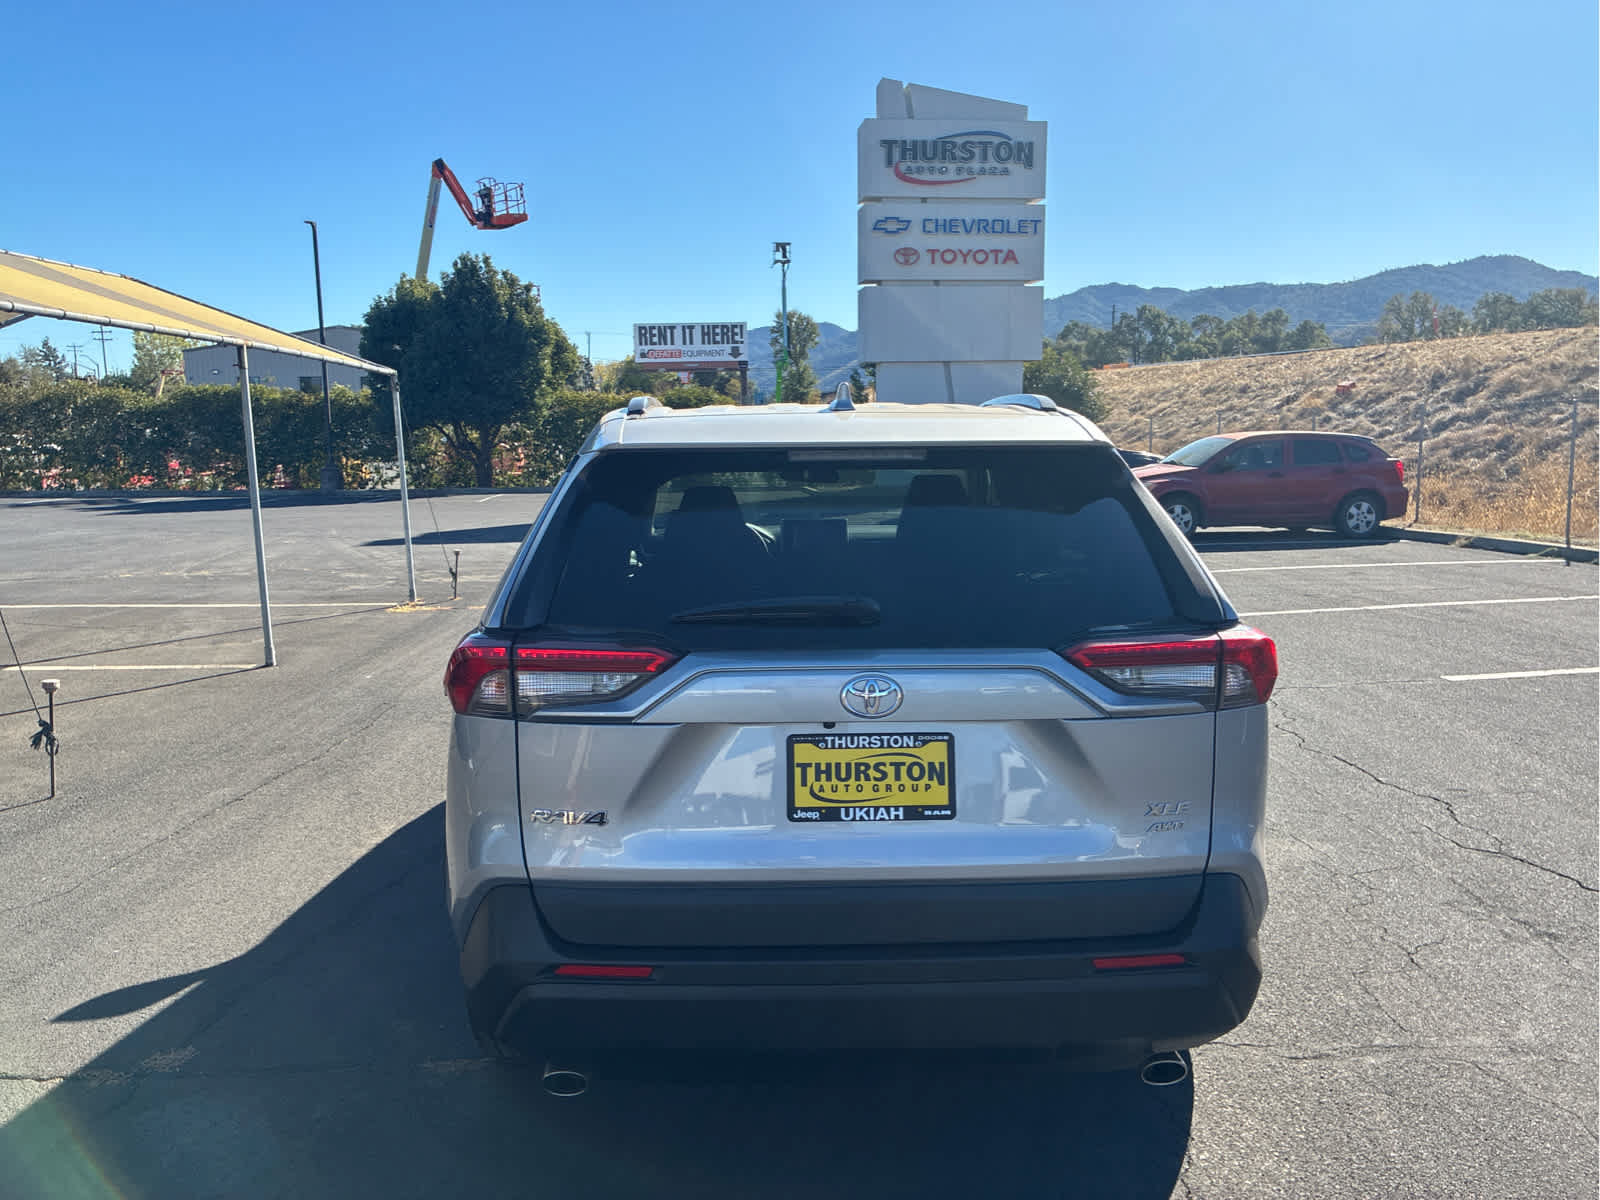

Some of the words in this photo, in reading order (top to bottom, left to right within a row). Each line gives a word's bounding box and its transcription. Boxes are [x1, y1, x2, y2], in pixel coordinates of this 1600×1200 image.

[880, 140, 1034, 169] THURSTON
[922, 218, 1042, 234] CHEVROLET
[927, 249, 1019, 264] TOYOTA
[638, 325, 676, 346] RENT
[681, 325, 696, 345] IT
[701, 324, 744, 345] HERE!
[824, 736, 914, 749] THURSTON
[796, 761, 945, 787] THURSTON
[818, 784, 864, 793] AUTO
[872, 784, 932, 793] GROUP
[793, 810, 820, 819] Jeep
[840, 807, 904, 820] UKIAH
